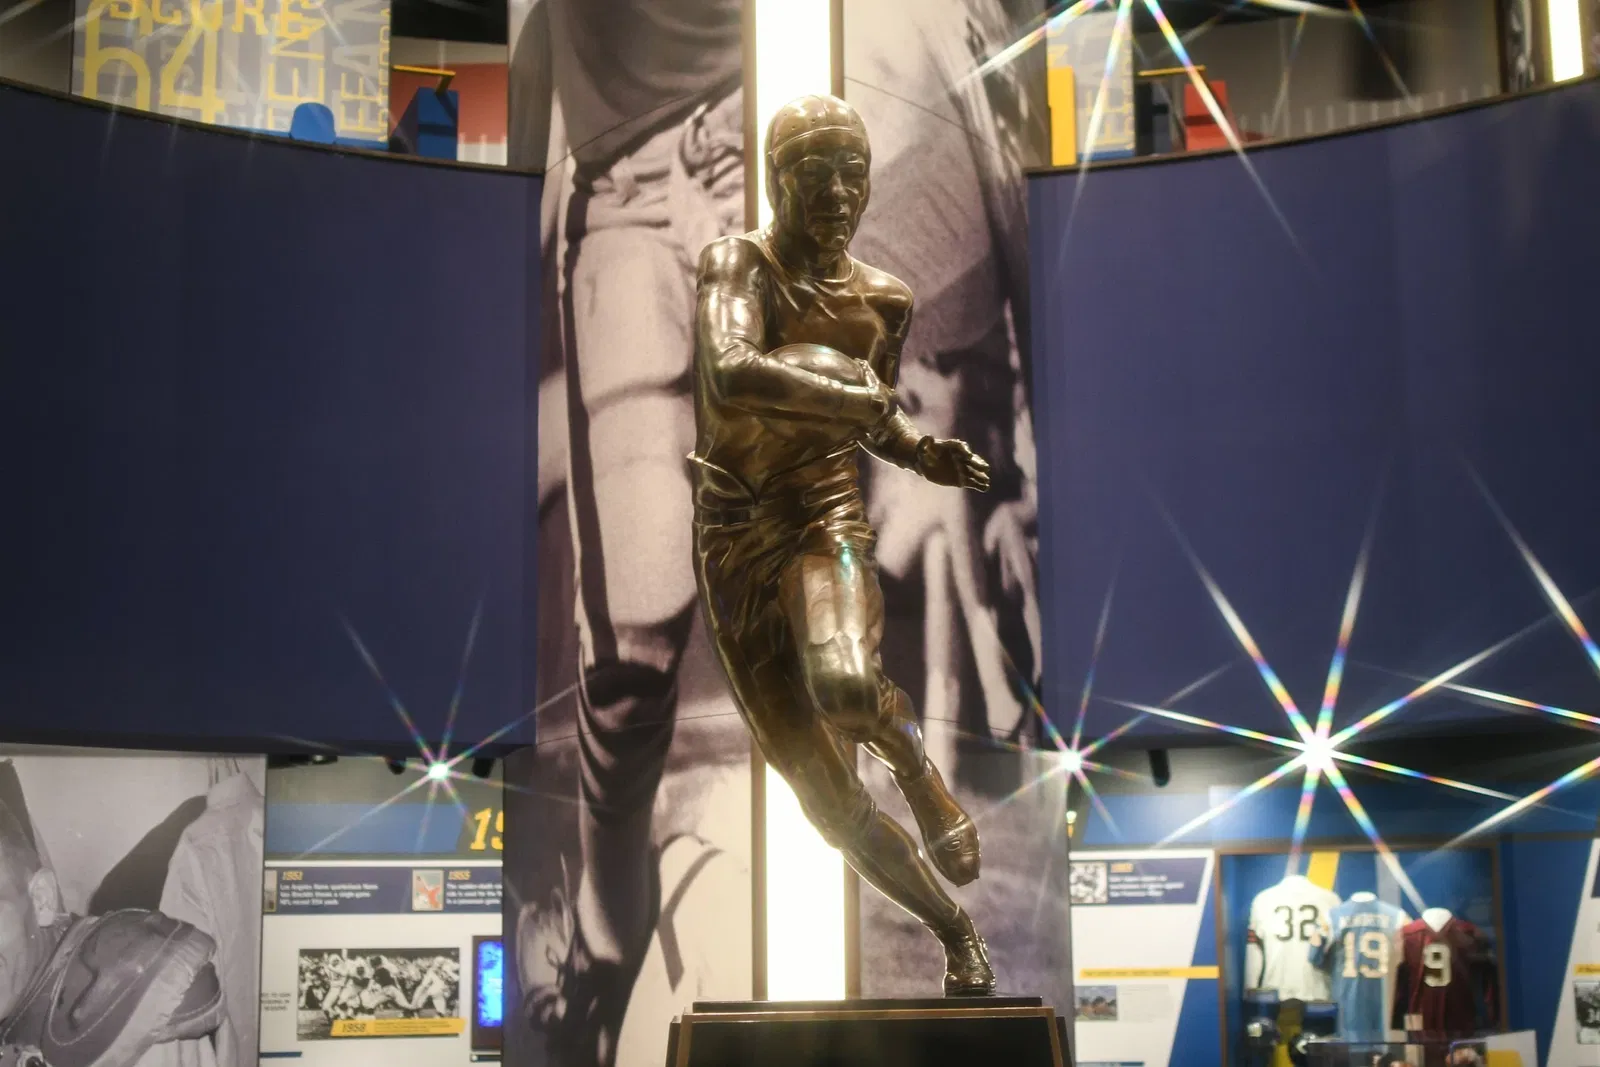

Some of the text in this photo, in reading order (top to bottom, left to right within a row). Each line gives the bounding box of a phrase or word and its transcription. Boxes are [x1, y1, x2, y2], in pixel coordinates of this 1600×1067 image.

[1274, 904, 1319, 941] 32
[1342, 931, 1389, 979] 19
[1423, 943, 1451, 988] 9
